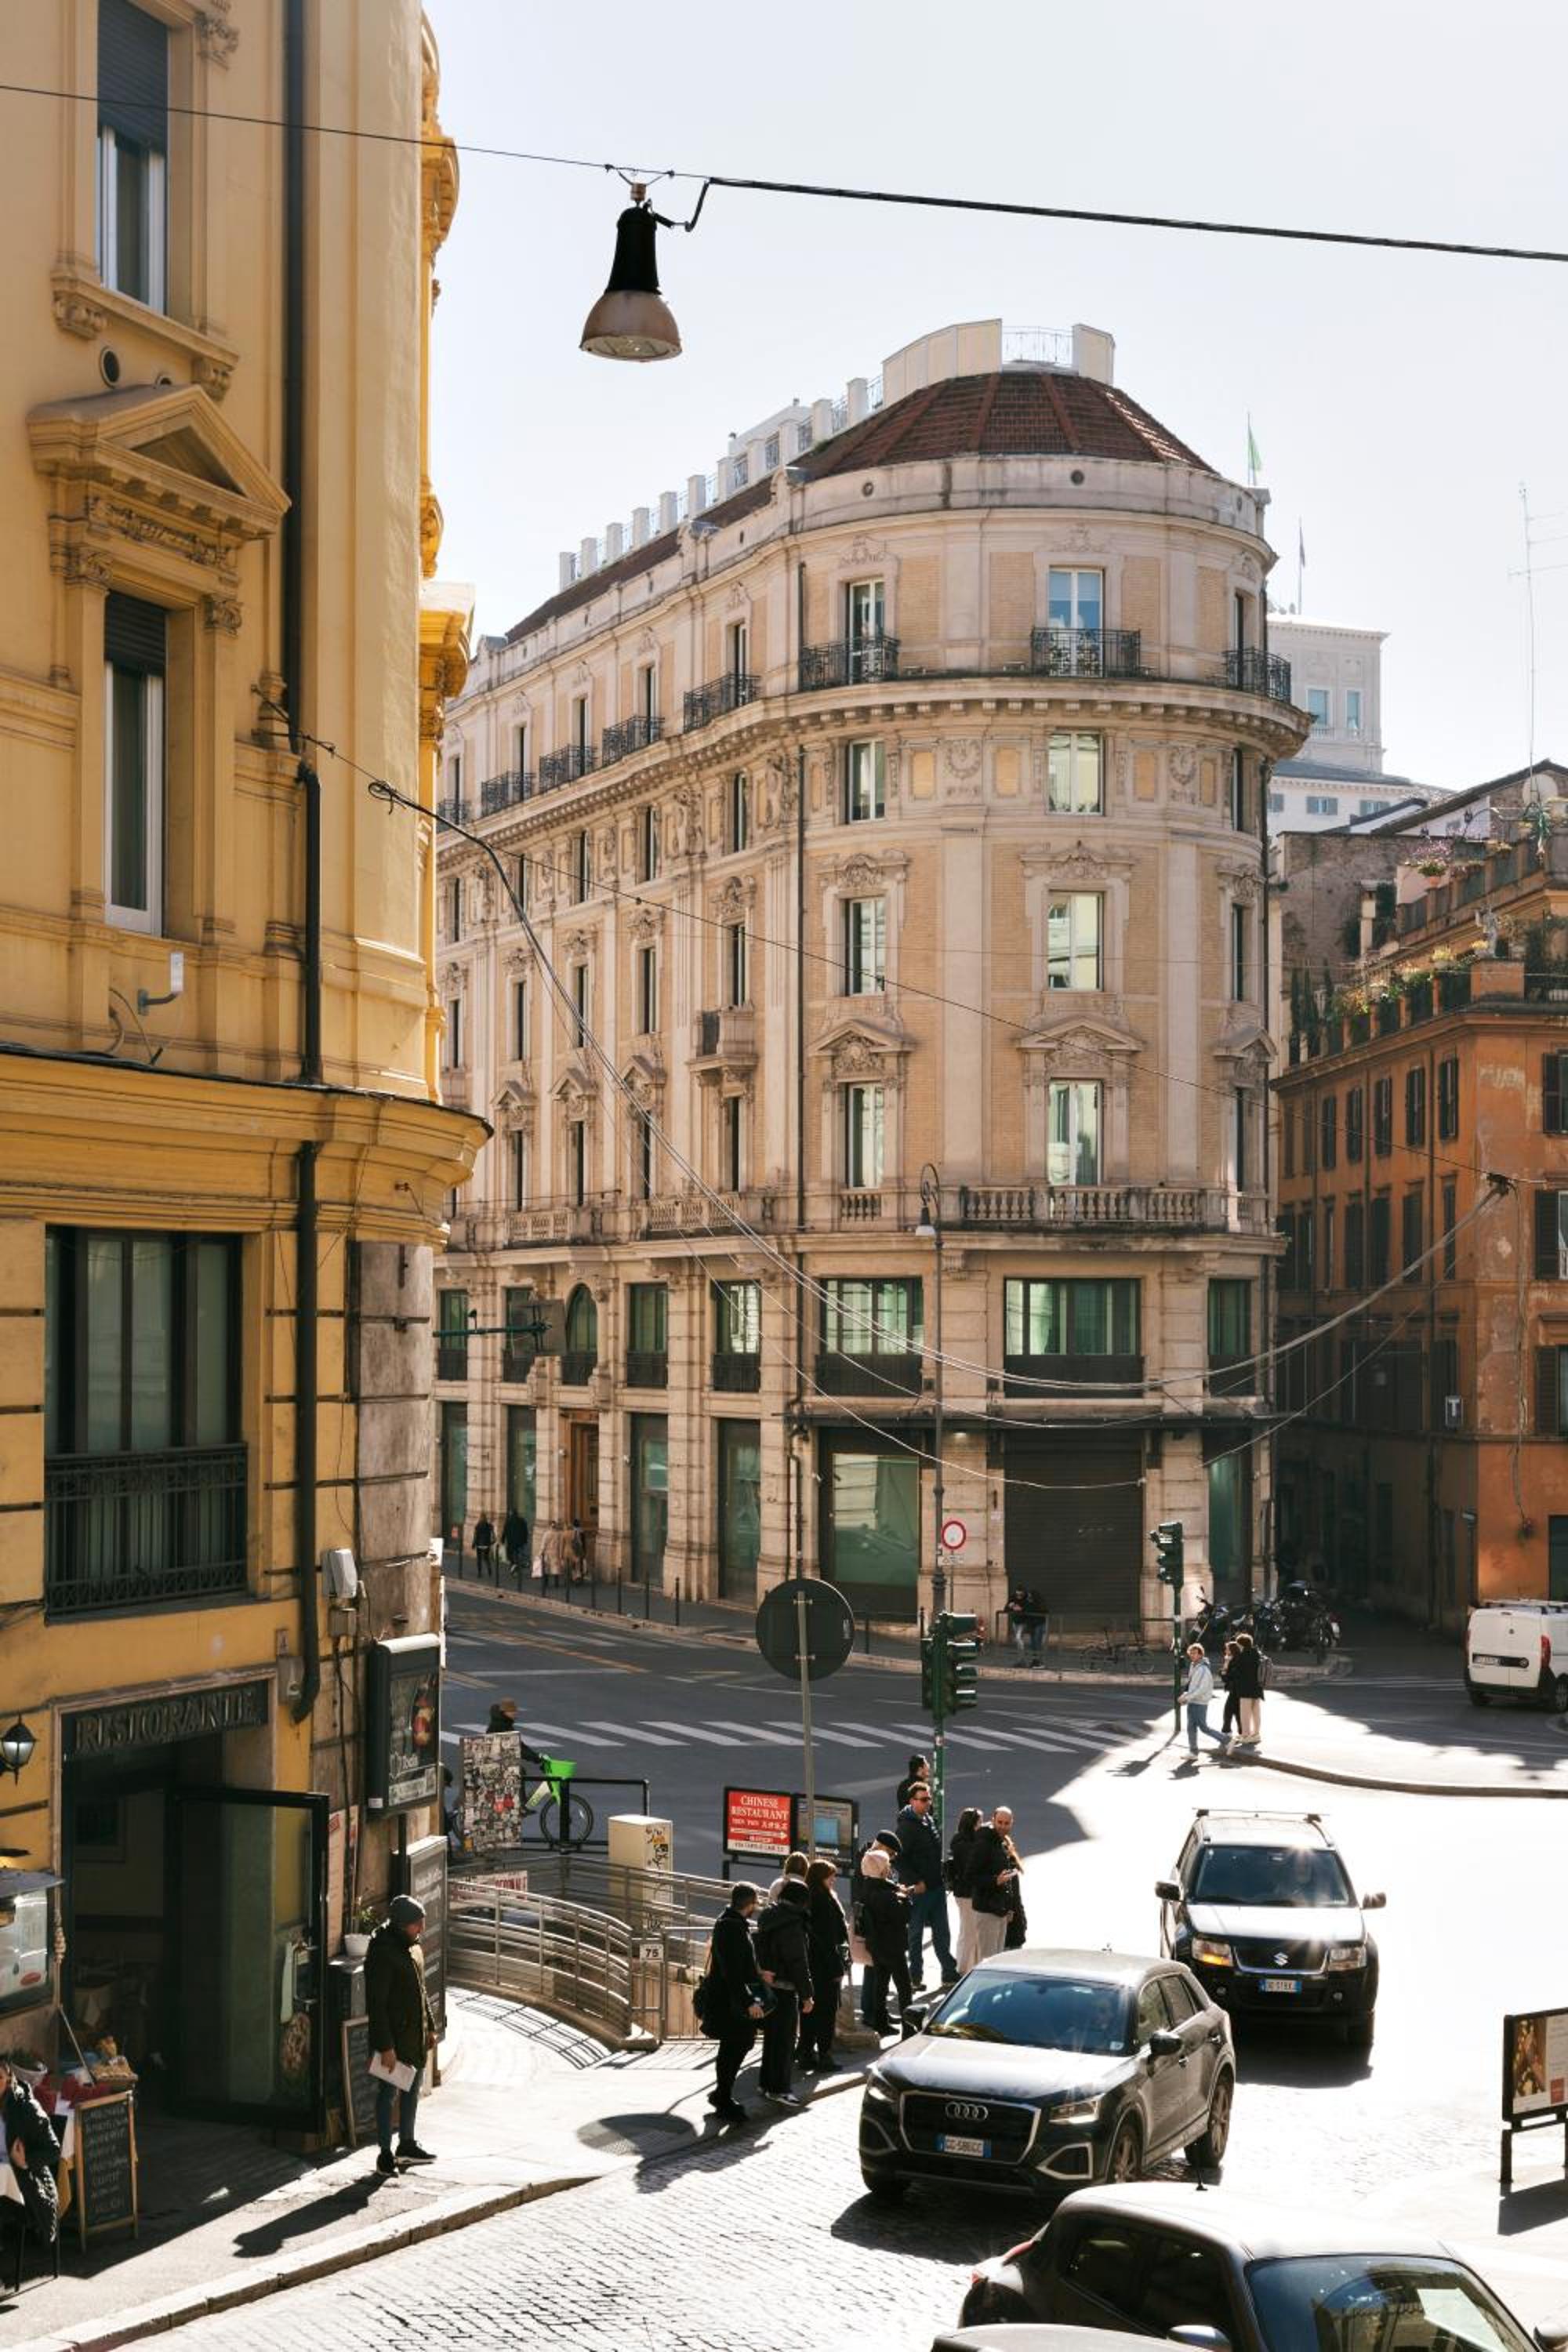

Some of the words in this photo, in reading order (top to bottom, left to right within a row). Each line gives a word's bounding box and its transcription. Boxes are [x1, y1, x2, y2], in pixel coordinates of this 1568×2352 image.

[76, 1690, 252, 1752] RISTORANTE
[740, 1795, 778, 1809] CHINESE
[731, 1806, 789, 1820] RESTAURANT
